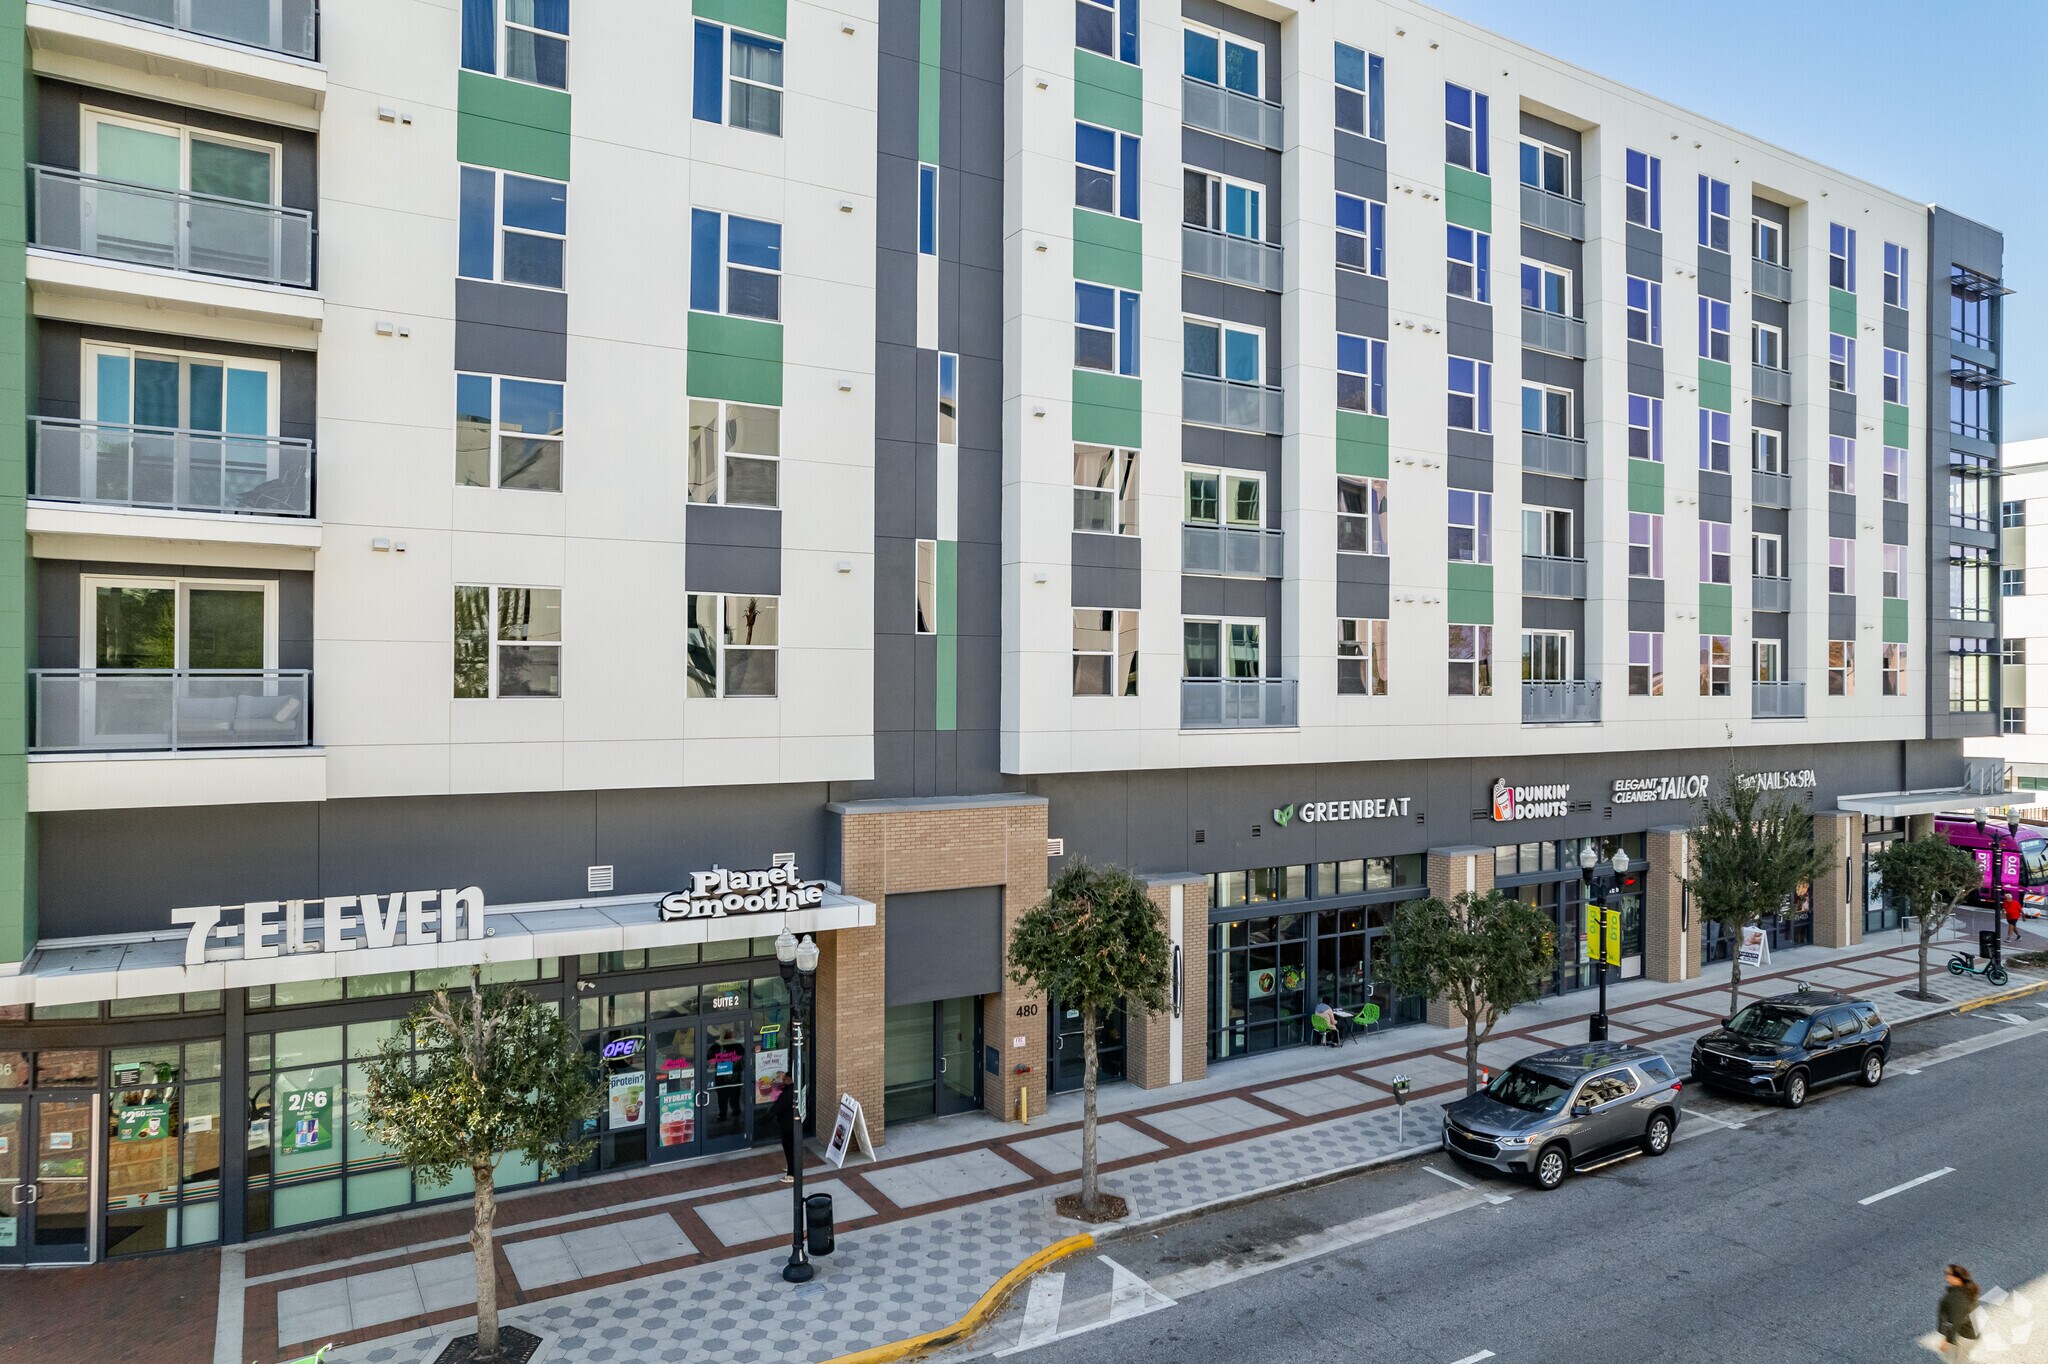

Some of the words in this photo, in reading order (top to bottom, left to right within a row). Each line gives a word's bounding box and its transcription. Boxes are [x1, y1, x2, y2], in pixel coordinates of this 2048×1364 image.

[1613, 778, 1658, 791] ELEGANT
[1660, 775, 1709, 800] TAILOR
[1756, 772, 1789, 793] NAILS
[1799, 770, 1816, 787] SPA
[1515, 784, 1570, 802] DUNKIN'
[1612, 790, 1658, 804] CLEANERS
[1299, 797, 1411, 823] GREENBEAT
[1515, 801, 1568, 820] DONUTS
[2008, 855, 2017, 875] DTO
[689, 861, 800, 897] Planet
[662, 883, 823, 921] Smoothie
[713, 996, 733, 1008] SUITE
[734, 995, 740, 1005] 2
[1016, 1004, 1038, 1017] 480
[603, 1039, 642, 1057] OPEN
[611, 1074, 644, 1089] protein?
[288, 1091, 327, 1110] 2/$6
[663, 1093, 693, 1104] HYDRATE
